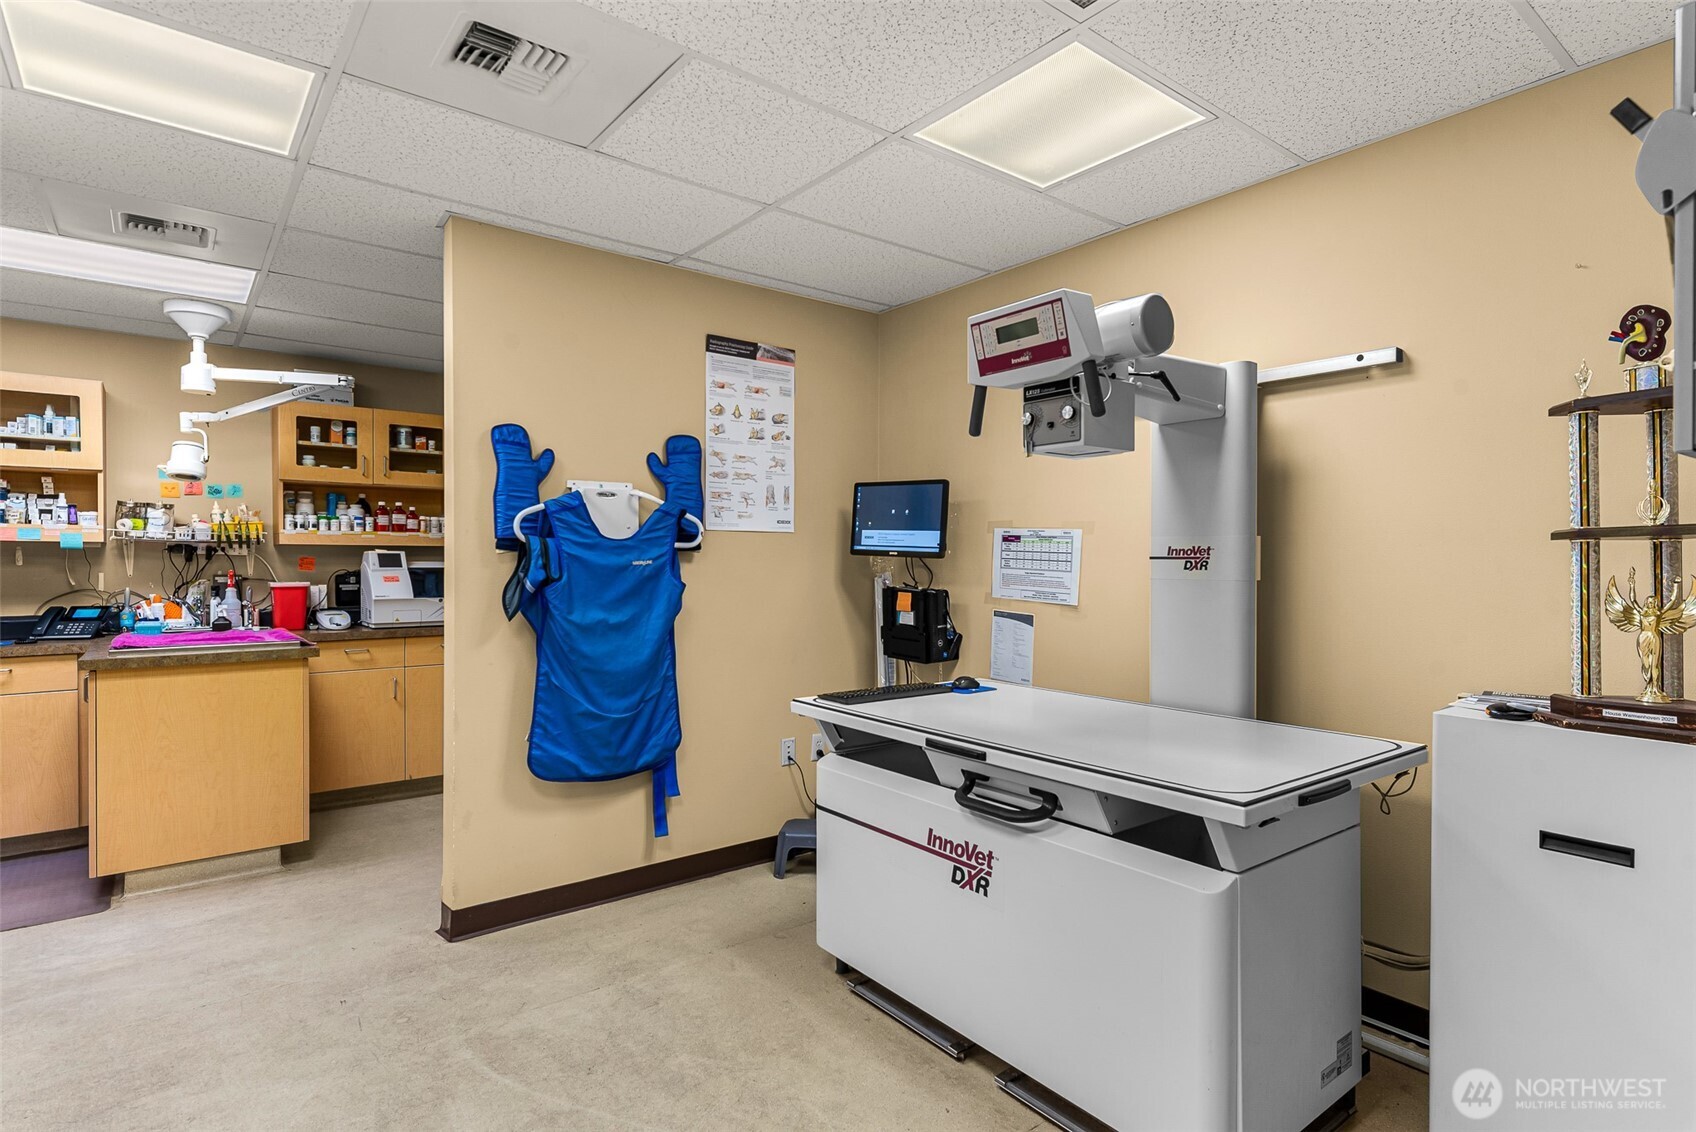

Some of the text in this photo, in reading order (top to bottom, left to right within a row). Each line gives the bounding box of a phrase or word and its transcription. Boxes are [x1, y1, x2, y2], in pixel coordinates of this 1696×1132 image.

[1167, 545, 1212, 557] InnoVet
[1183, 557, 1209, 571] DXR
[926, 827, 995, 871] InnoVet
[950, 864, 991, 898] DXR
